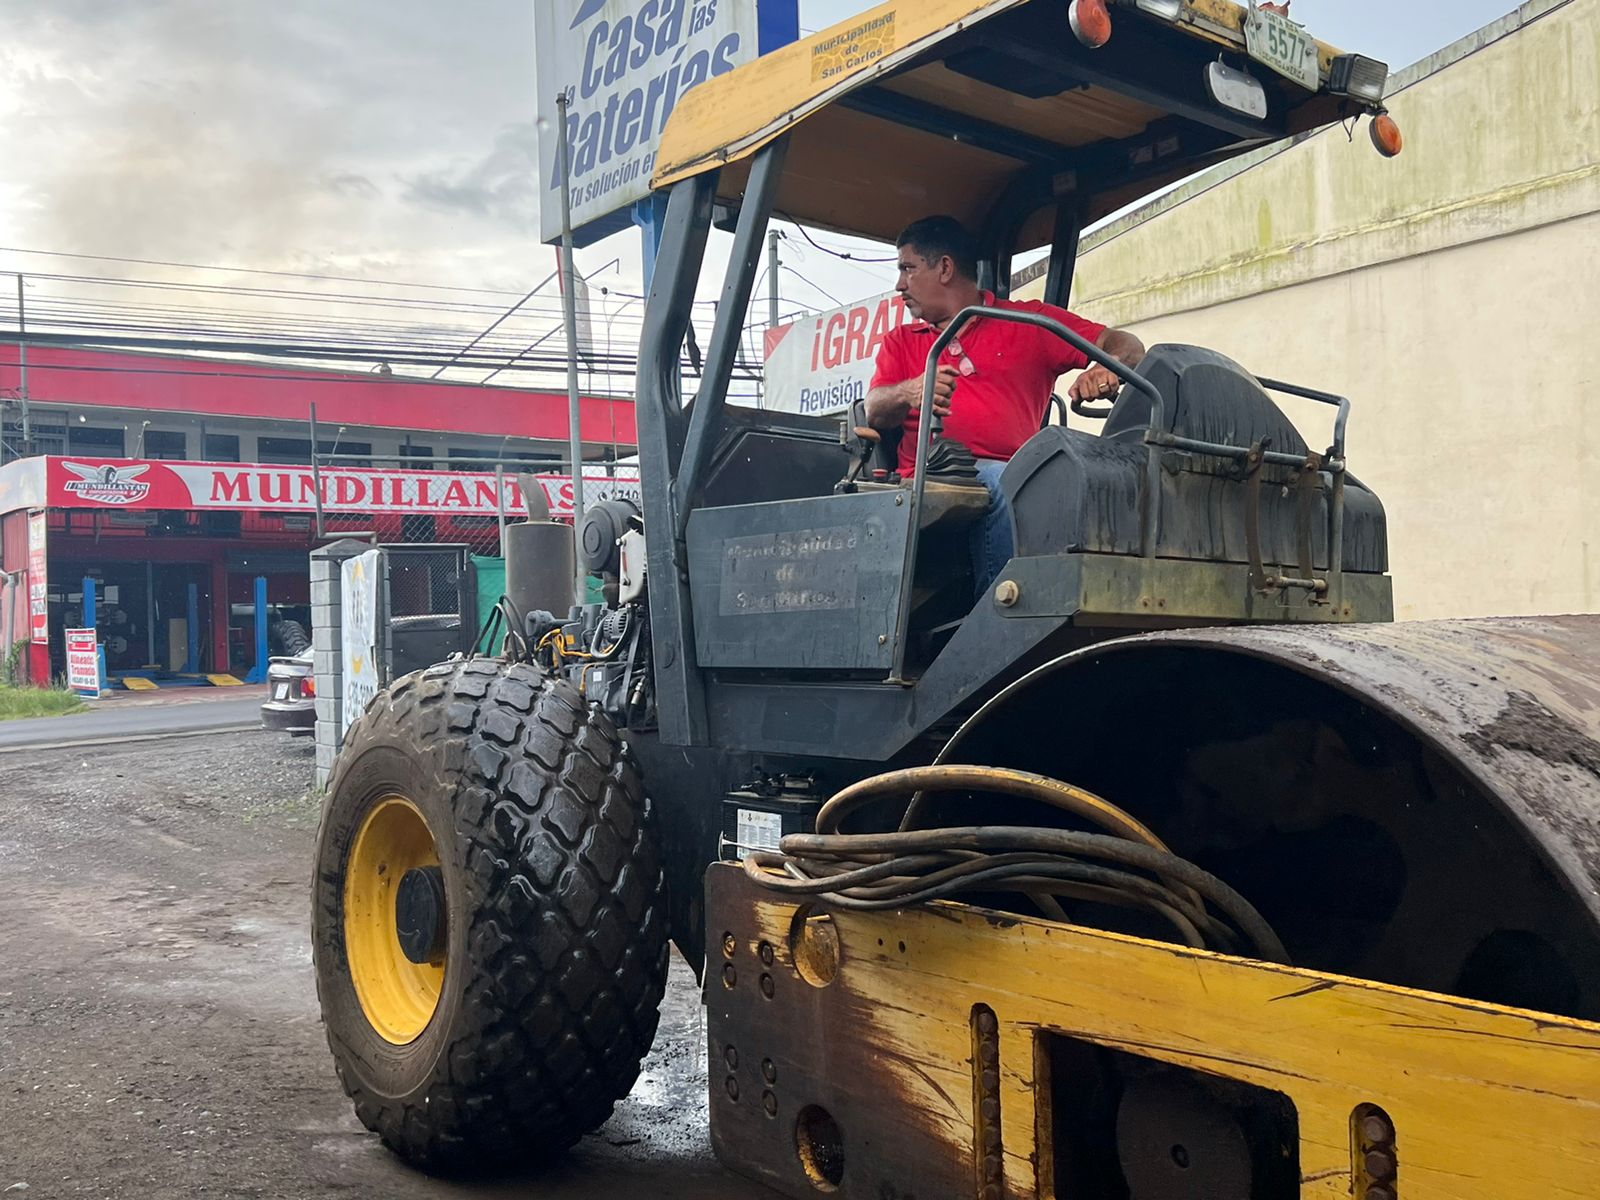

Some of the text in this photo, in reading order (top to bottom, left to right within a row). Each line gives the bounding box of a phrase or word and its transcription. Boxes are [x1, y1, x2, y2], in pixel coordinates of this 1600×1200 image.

[687, 0, 718, 37] las
[814, 11, 896, 55] Municipalidad
[580, 0, 686, 99] Casa
[822, 47, 883, 79] San Carlos
[845, 44, 860, 55] de
[1267, 22, 1306, 68] 5577
[569, 186, 584, 210] Tu
[585, 157, 640, 203] solución
[799, 375, 864, 413] Revisión
[76, 482, 147, 491] MUNDILLANTAS
